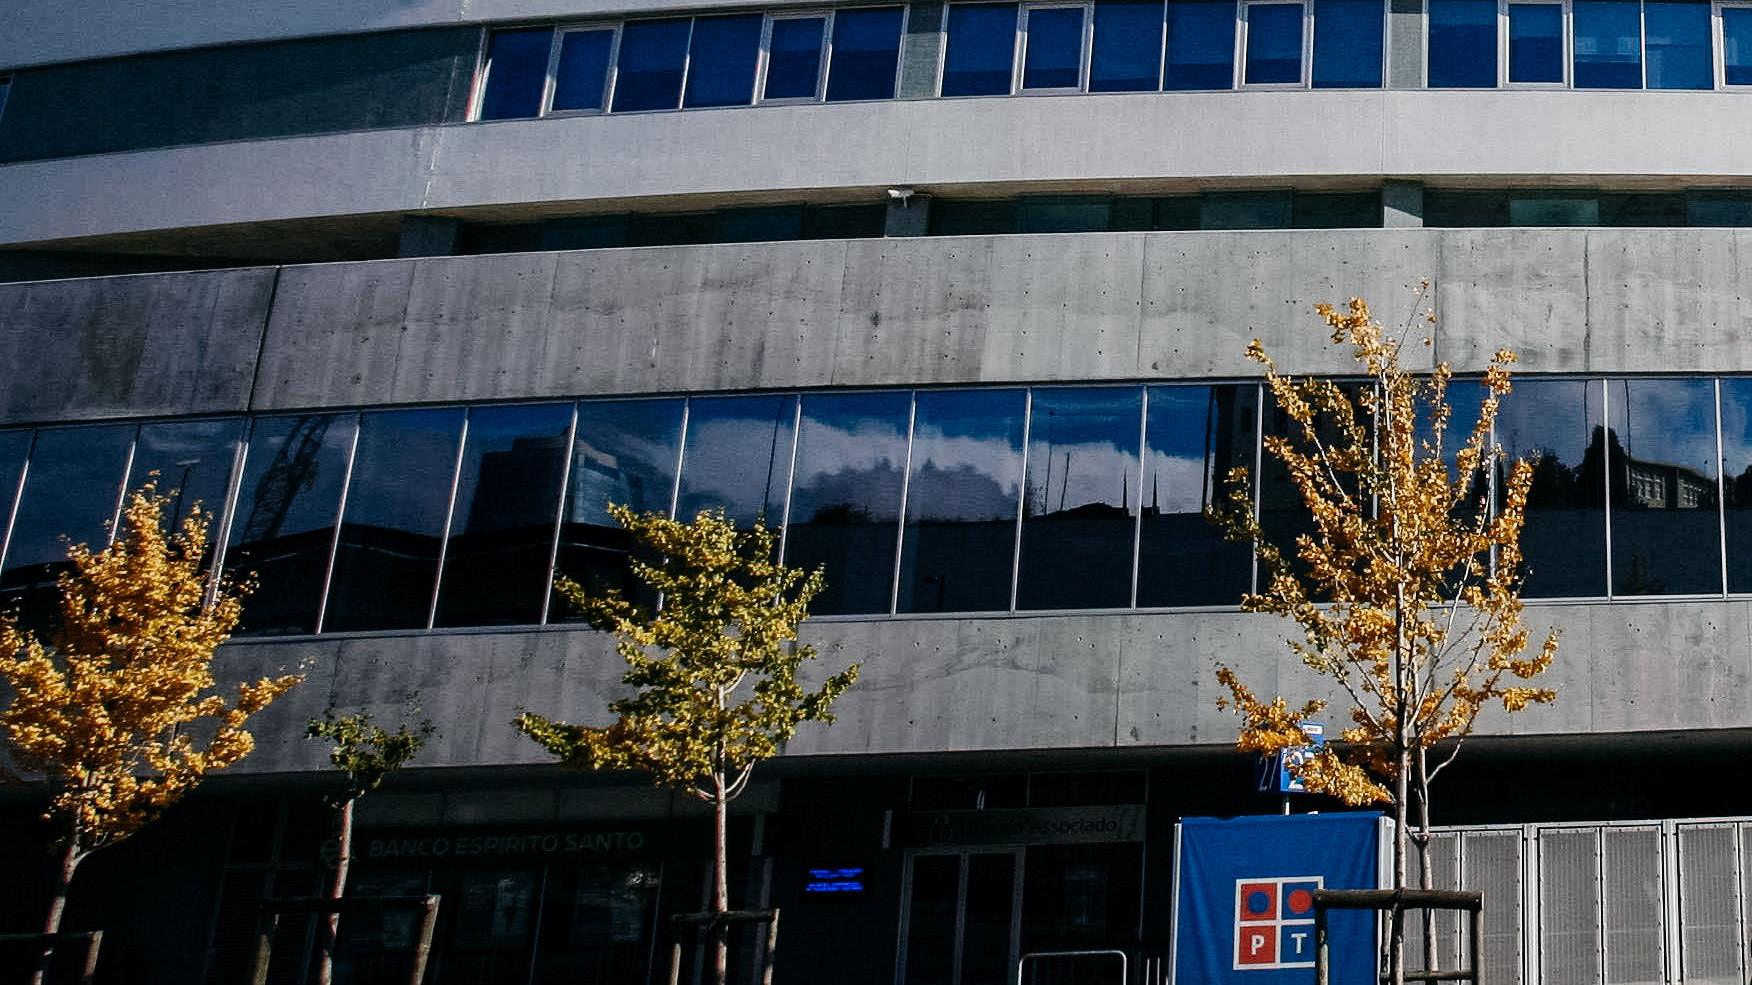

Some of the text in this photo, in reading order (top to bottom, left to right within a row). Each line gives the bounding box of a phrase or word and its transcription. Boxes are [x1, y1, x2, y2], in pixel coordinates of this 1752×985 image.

[368, 838, 449, 858] BANCO
[563, 832, 645, 852] SANTO
[1250, 933, 1308, 956] PT
